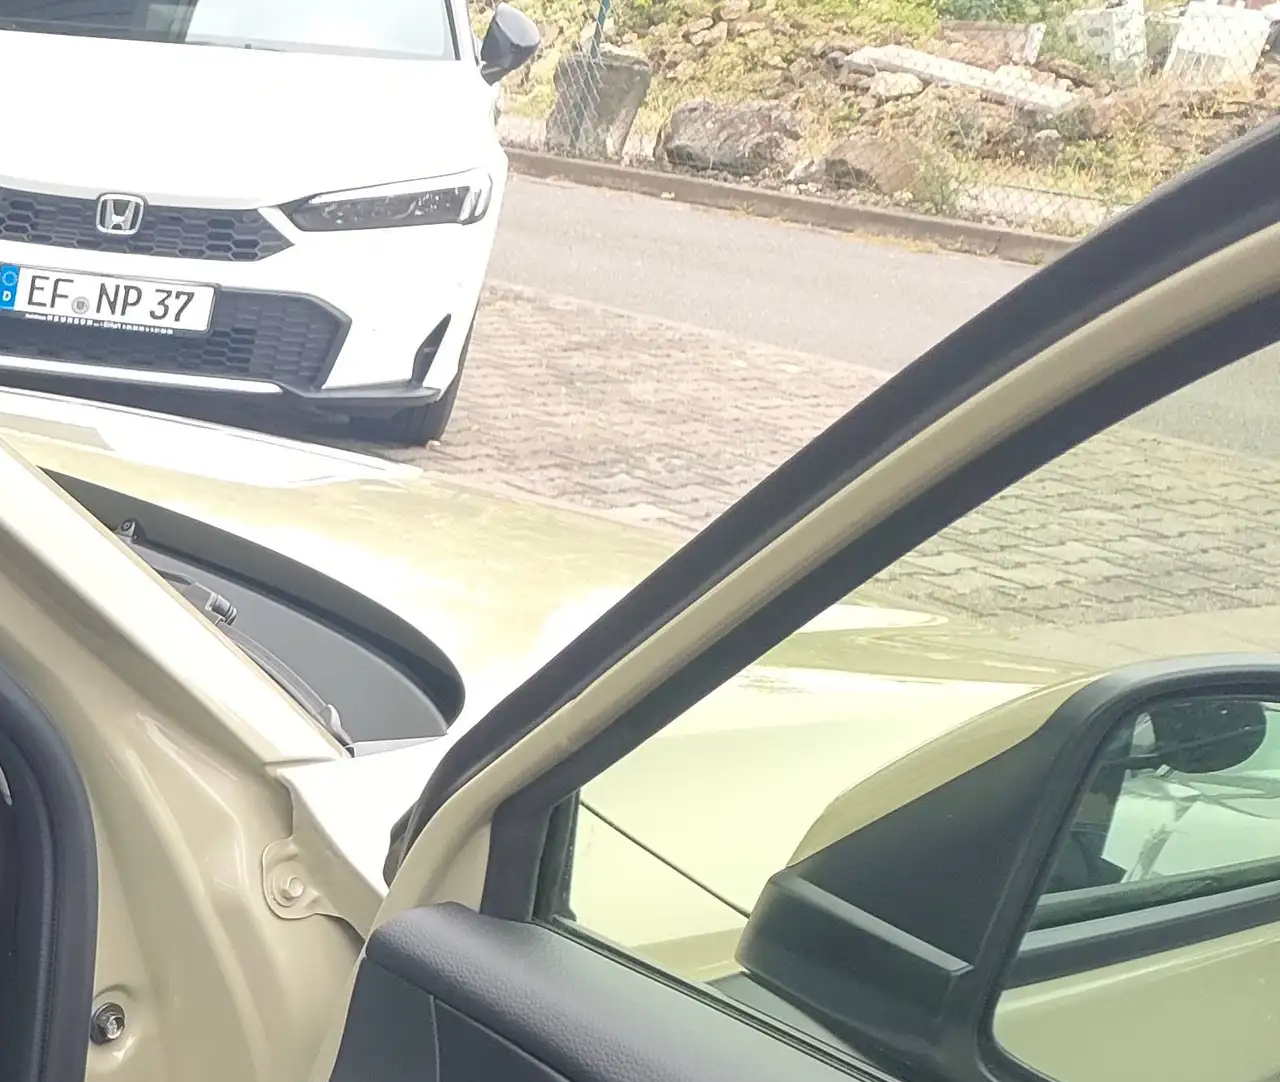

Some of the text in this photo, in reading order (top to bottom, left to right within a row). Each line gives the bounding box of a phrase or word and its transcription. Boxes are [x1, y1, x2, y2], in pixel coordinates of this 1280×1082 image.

[2, 290, 12, 301] D
[27, 275, 195, 322] EF NP 37
